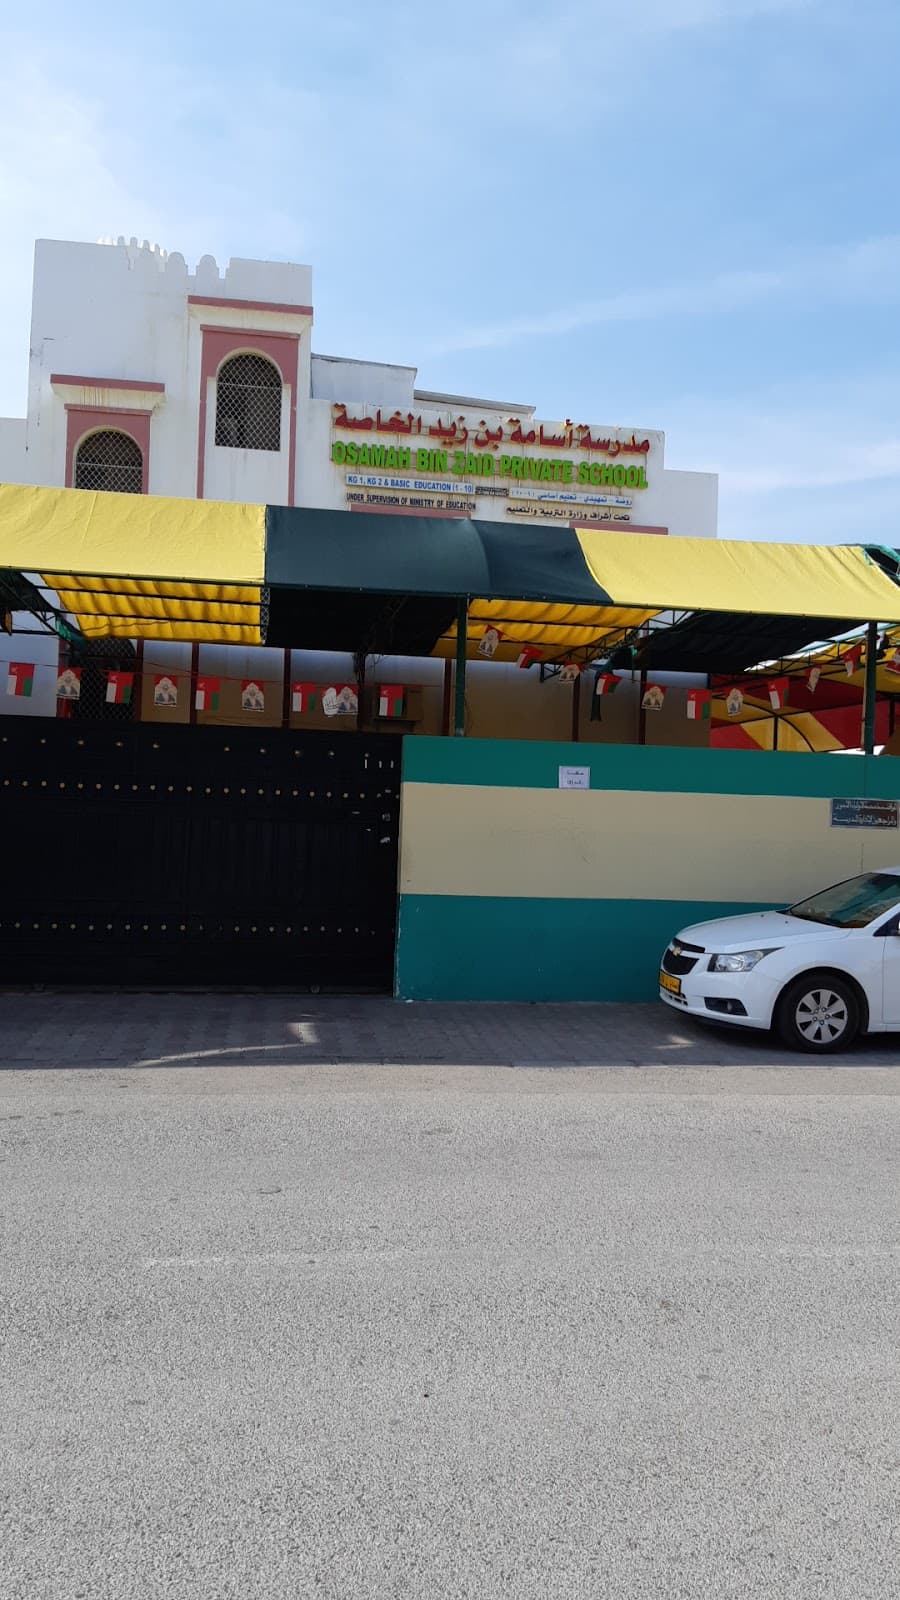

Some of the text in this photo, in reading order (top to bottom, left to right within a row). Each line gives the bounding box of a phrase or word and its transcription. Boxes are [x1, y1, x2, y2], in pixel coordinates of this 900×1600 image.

[333, 402, 650, 457] مدرسة أسامة بن زيد الخاصة
[332, 440, 649, 489] OSAMAH BIN ZAID PRIVATE SCHOOL
[348, 475, 358, 484] KG
[367, 477, 377, 485] KG
[378, 478, 383, 486] 2
[384, 478, 389, 486] &
[390, 479, 410, 488] BASIC
[414, 480, 451, 491] EDUCATION
[346, 492, 476, 510] UNDER SUPERVISION OF MINISTRY OF EDUCATION
[506, 505, 538, 515] والتعليم
[540, 507, 566, 517] التربية
[569, 509, 587, 520] وزارة
[613, 511, 630, 521] تحت
